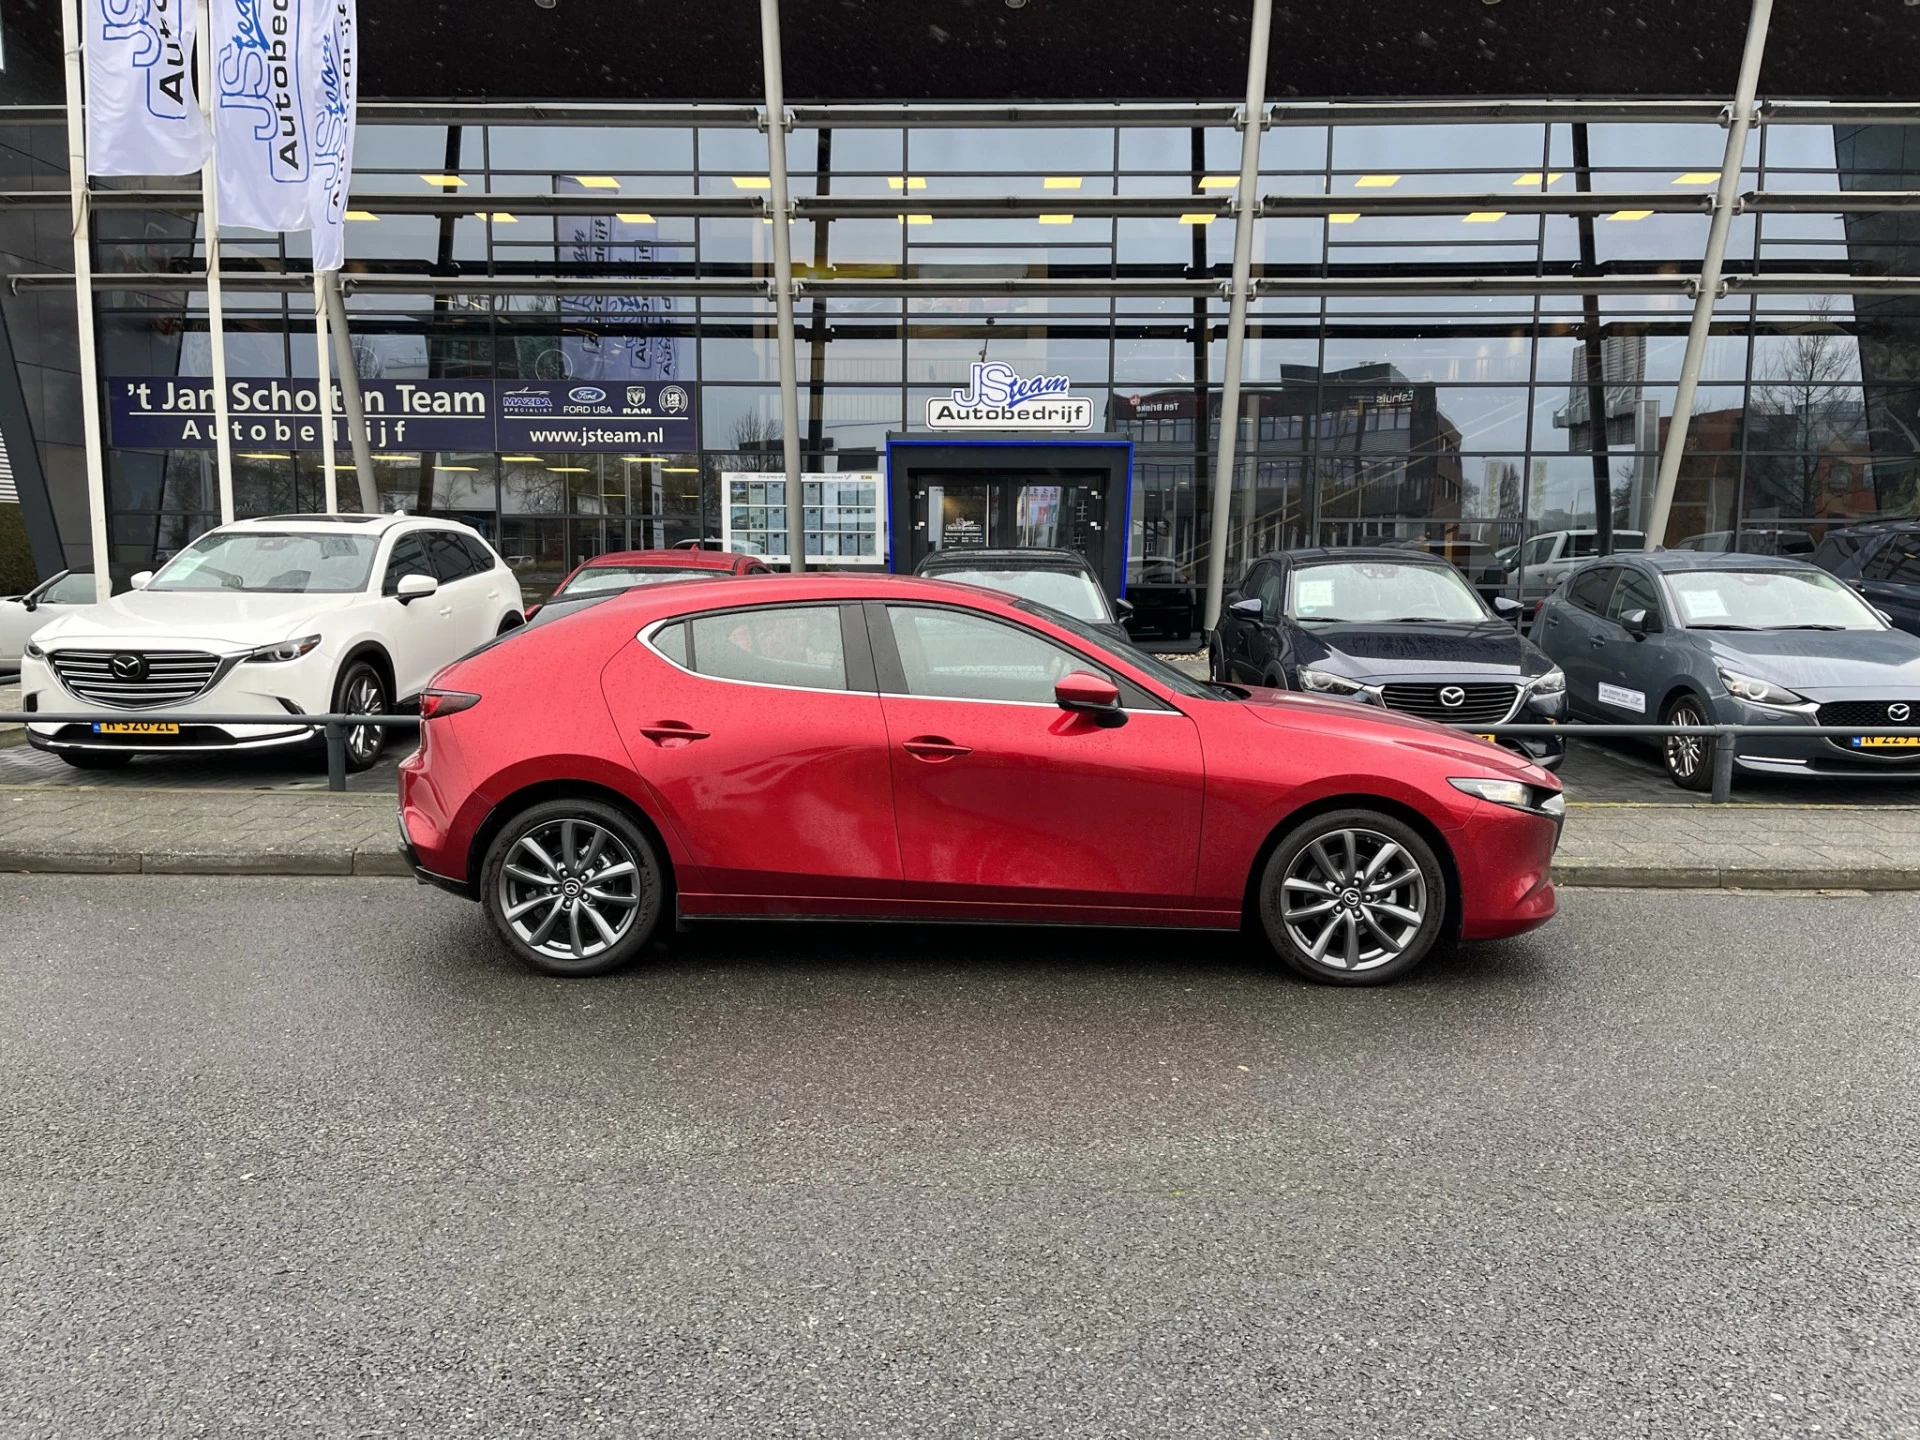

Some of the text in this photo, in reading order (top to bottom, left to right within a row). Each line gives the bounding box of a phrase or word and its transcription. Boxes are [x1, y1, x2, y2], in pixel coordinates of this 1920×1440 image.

[162, 382, 216, 410] Jan
[232, 381, 384, 412] Schotn
[396, 384, 485, 413] Team
[576, 391, 597, 401] Ford
[667, 393, 680, 401] US
[503, 397, 553, 407] MAZDA
[563, 405, 613, 414] FORD USA
[622, 407, 652, 415] RAM
[937, 405, 1083, 423] Autobedrijf
[182, 419, 405, 447] Autobeijf
[530, 427, 663, 446] www.jsteam.nl
